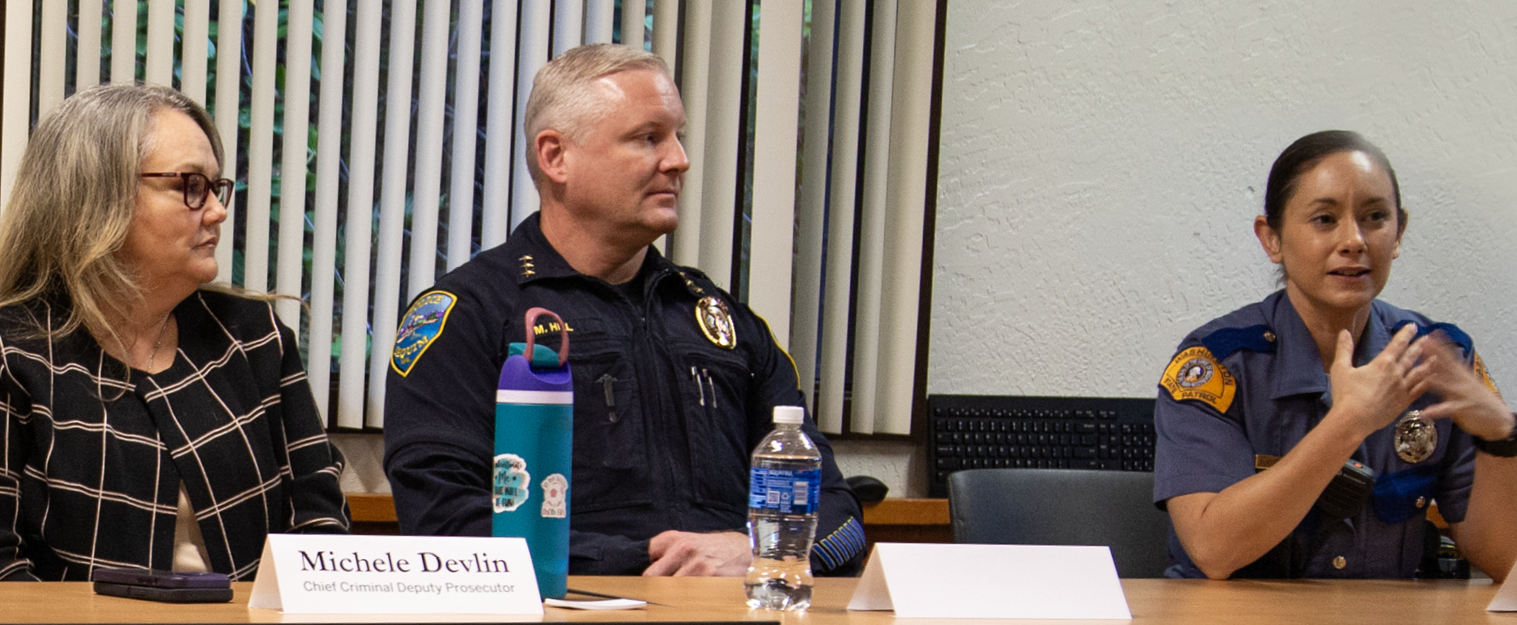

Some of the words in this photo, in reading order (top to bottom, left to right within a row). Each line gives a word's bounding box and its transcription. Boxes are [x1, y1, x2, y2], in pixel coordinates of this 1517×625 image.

[549, 322, 574, 332] HIL
[1181, 391, 1217, 405] PATROL
[298, 550, 411, 573] Michele
[417, 552, 510, 573] Devlin
[302, 580, 337, 592] Chief
[340, 581, 394, 593] Criminal
[396, 582, 443, 596] Deputy
[446, 582, 516, 594] Prosecutor
